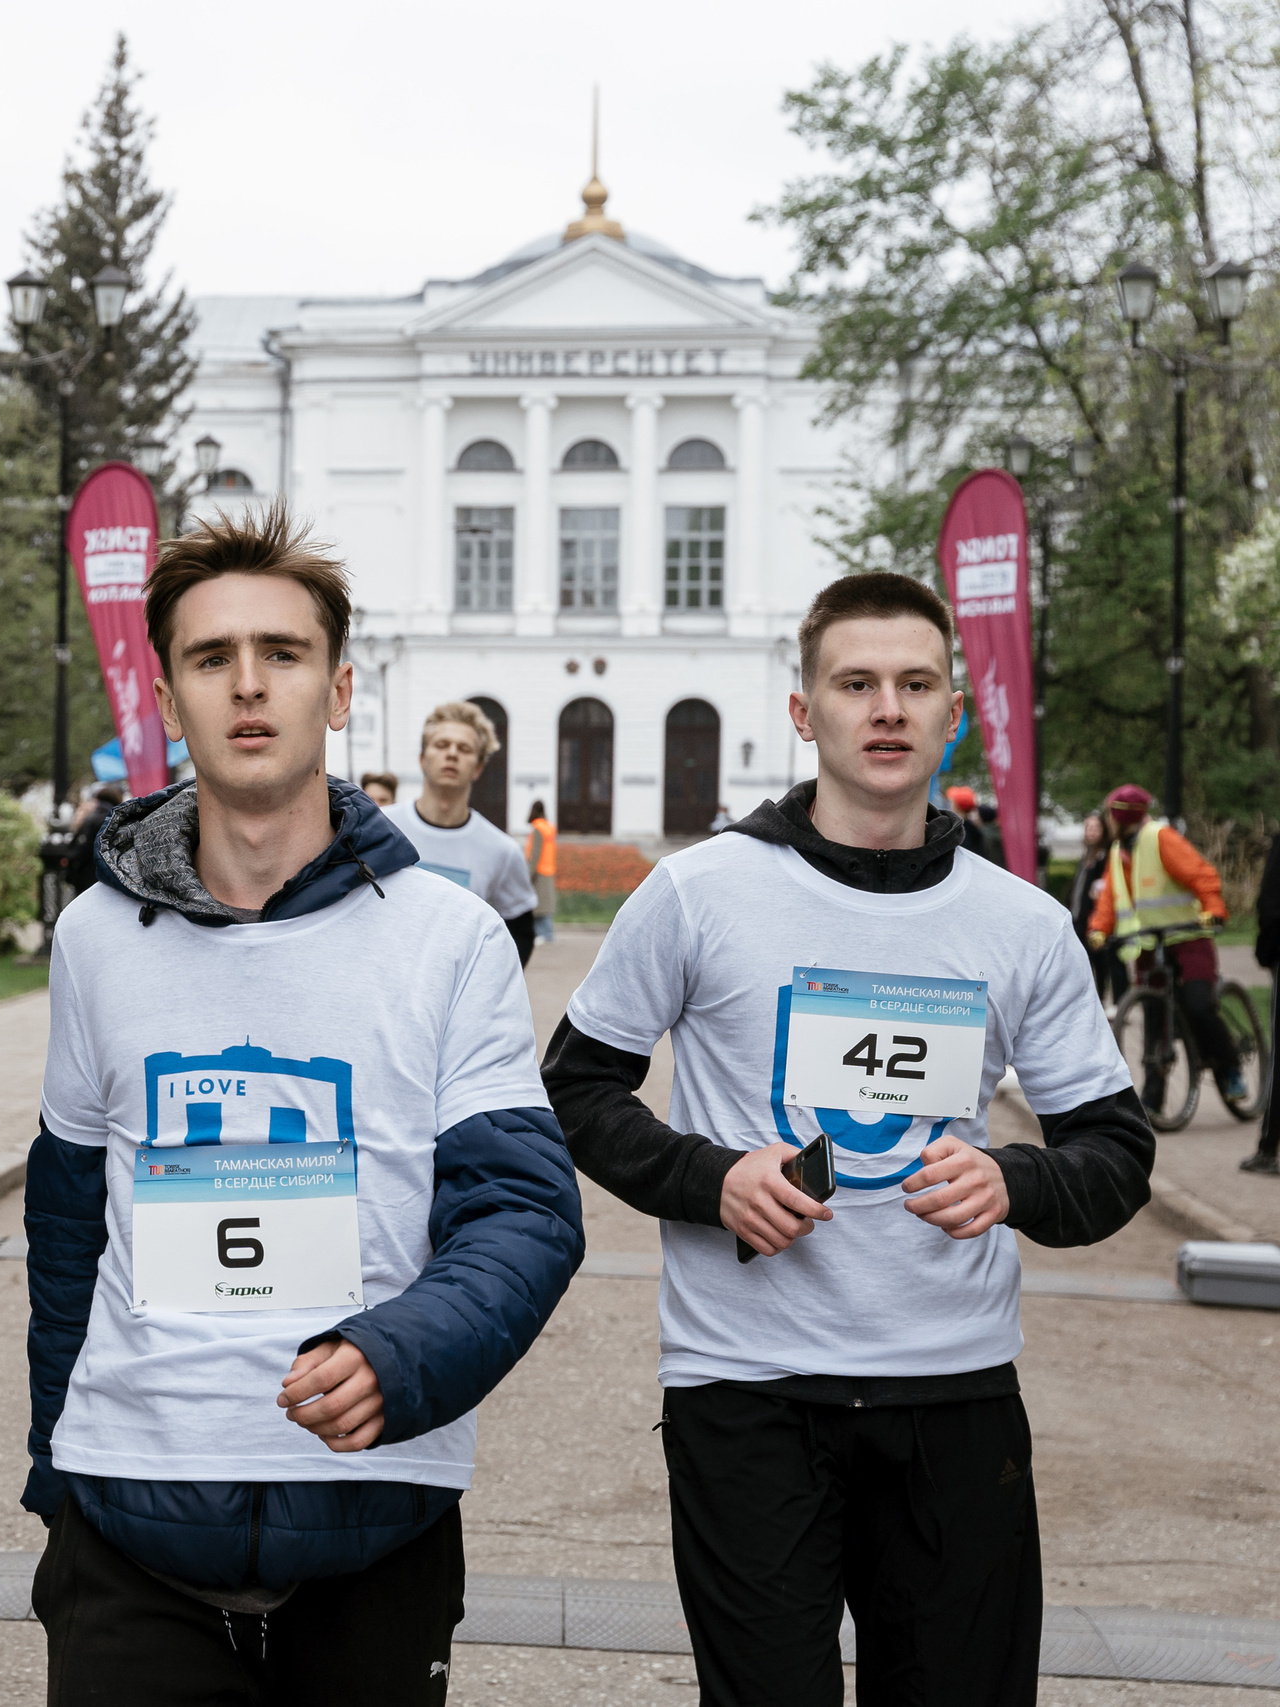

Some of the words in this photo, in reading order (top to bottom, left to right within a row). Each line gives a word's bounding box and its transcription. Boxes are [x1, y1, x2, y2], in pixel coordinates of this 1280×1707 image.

[872, 984, 940, 999] ТАМАНСКАЯ
[942, 990, 974, 1001] МИЛЯ
[870, 999, 878, 1009] В
[880, 1000, 925, 1014] СЕРДЦЕ
[926, 1004, 971, 1016] СИБИРИ
[842, 1033, 928, 1080] 42
[169, 1082, 174, 1098] I
[185, 1078, 247, 1097] LOVE
[867, 1091, 909, 1102] ЭФКО
[214, 1158, 294, 1171] ТАМАНСКАЯ
[296, 1155, 336, 1168] МИЛЯ
[214, 1178, 222, 1189] В
[224, 1176, 277, 1190] СЕРДЦЕ
[279, 1173, 334, 1187] СИБИРИ
[216, 1217, 265, 1269] 6
[224, 1286, 273, 1297] ЭФКО
